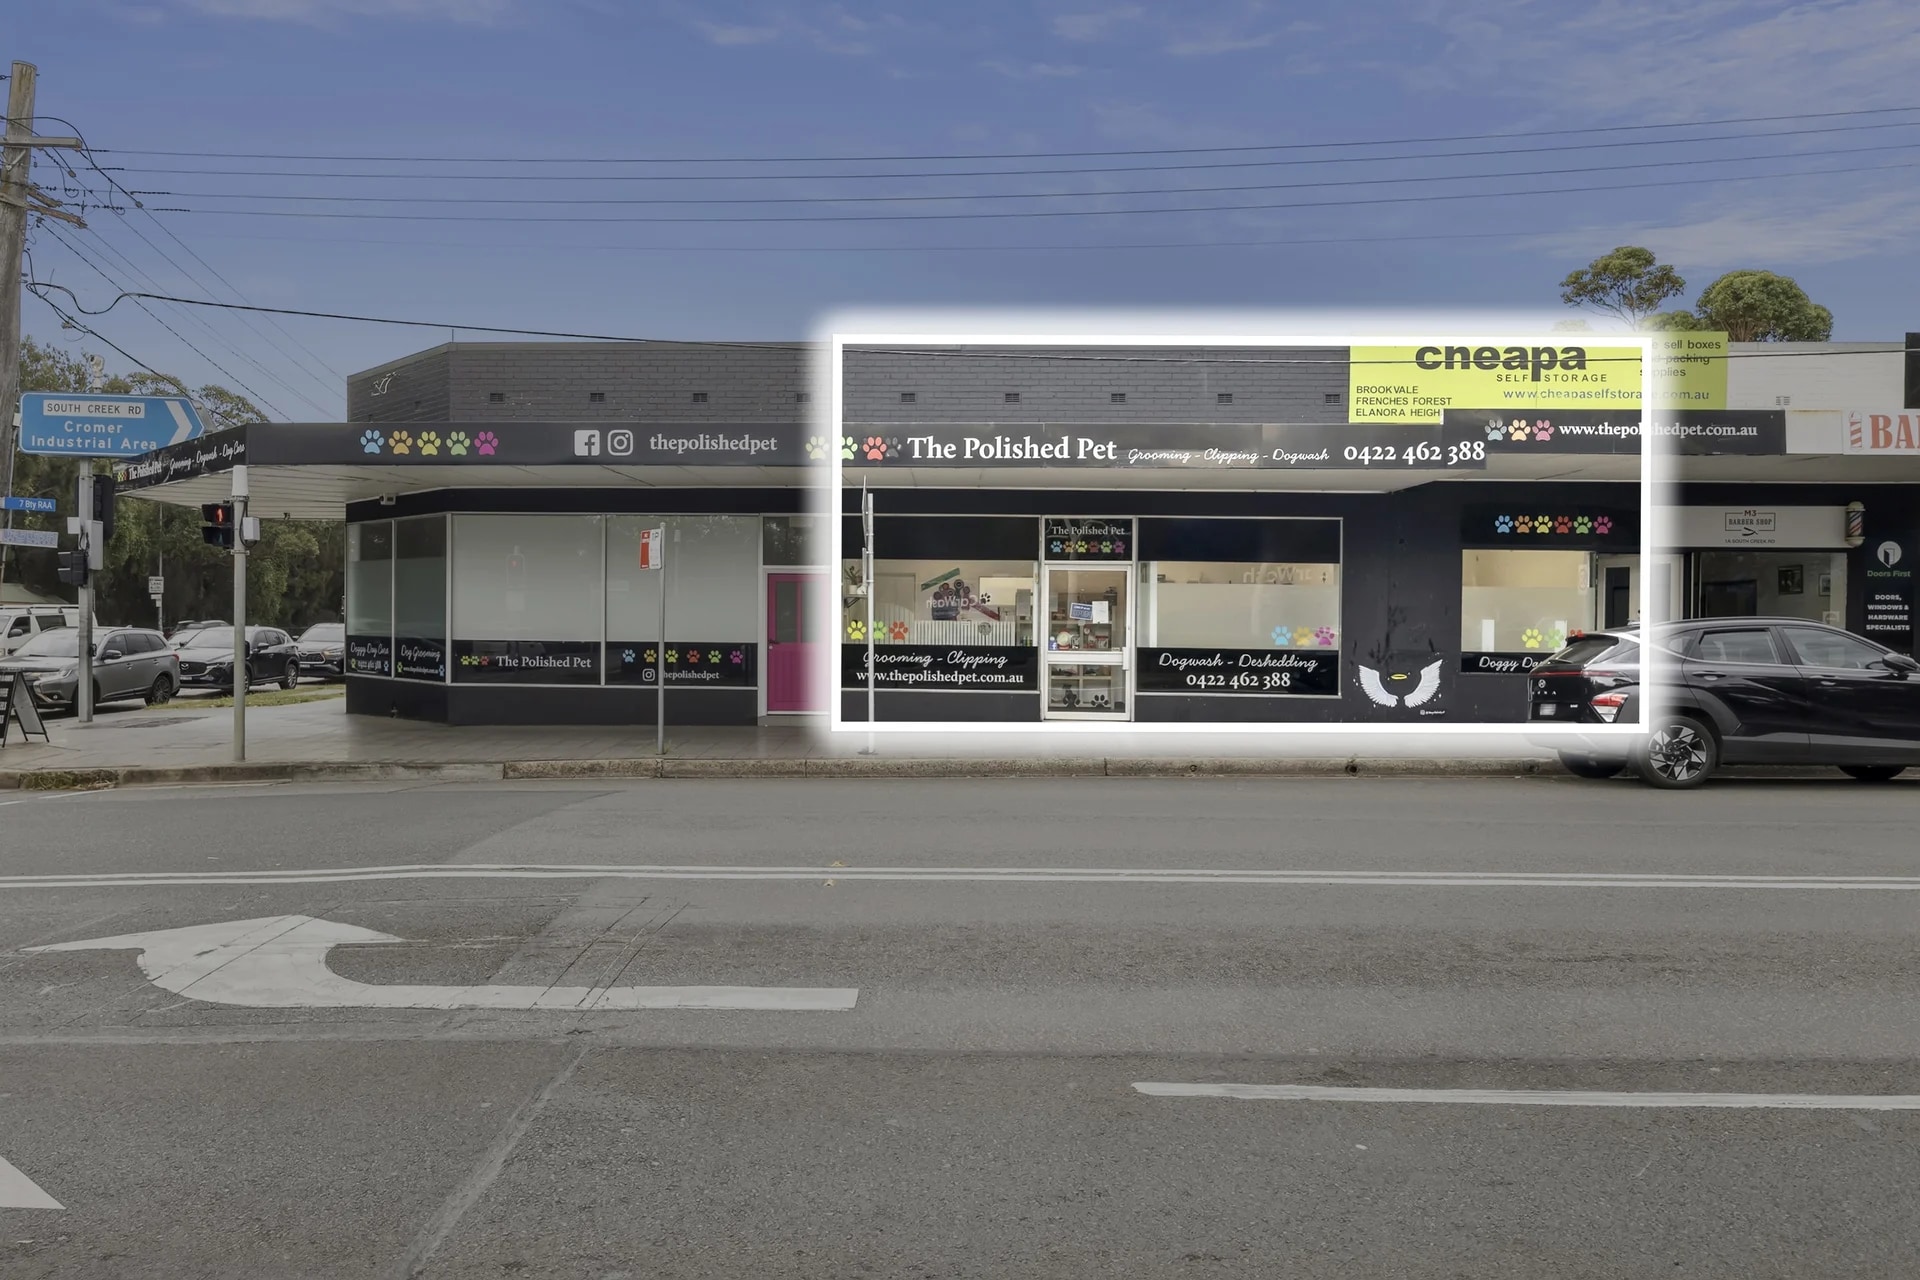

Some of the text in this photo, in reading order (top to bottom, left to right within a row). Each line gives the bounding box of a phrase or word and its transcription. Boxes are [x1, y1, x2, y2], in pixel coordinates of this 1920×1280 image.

[1664, 340, 1682, 350] sell
[1688, 340, 1721, 350] boxes
[1666, 354, 1710, 365] packing
[1496, 374, 1608, 382] SELF STORAGE
[1356, 386, 1418, 394] BROOKVALE
[1356, 397, 1452, 406] FRENCHES FOREST
[47, 403, 141, 415] SOUTH CREEK RD
[1356, 408, 1406, 417] ELANORA
[64, 420, 124, 433] Cromer
[1869, 414, 1920, 449] BA
[31, 434, 157, 450] Industrial Area
[650, 433, 778, 455] thepolishedpet
[906, 436, 1118, 460] The Polished Pet
[1128, 448, 1191, 464] Grooming
[1203, 448, 1259, 464] Clipping
[1272, 448, 1329, 464] Dogwash
[1344, 441, 1485, 465] 0422 462 388
[1052, 526, 1125, 535] The Polished Pet
[401, 644, 412, 660] Dog
[496, 656, 592, 668] The Polished Pet
[947, 650, 1008, 669] Clipping
[1159, 653, 1224, 671] Dogwash
[1238, 654, 1318, 672] Deshedding
[1479, 656, 1519, 672] Doggy
[661, 670, 720, 680] hepolishedpet
[1186, 672, 1291, 690] 0422 462 388
